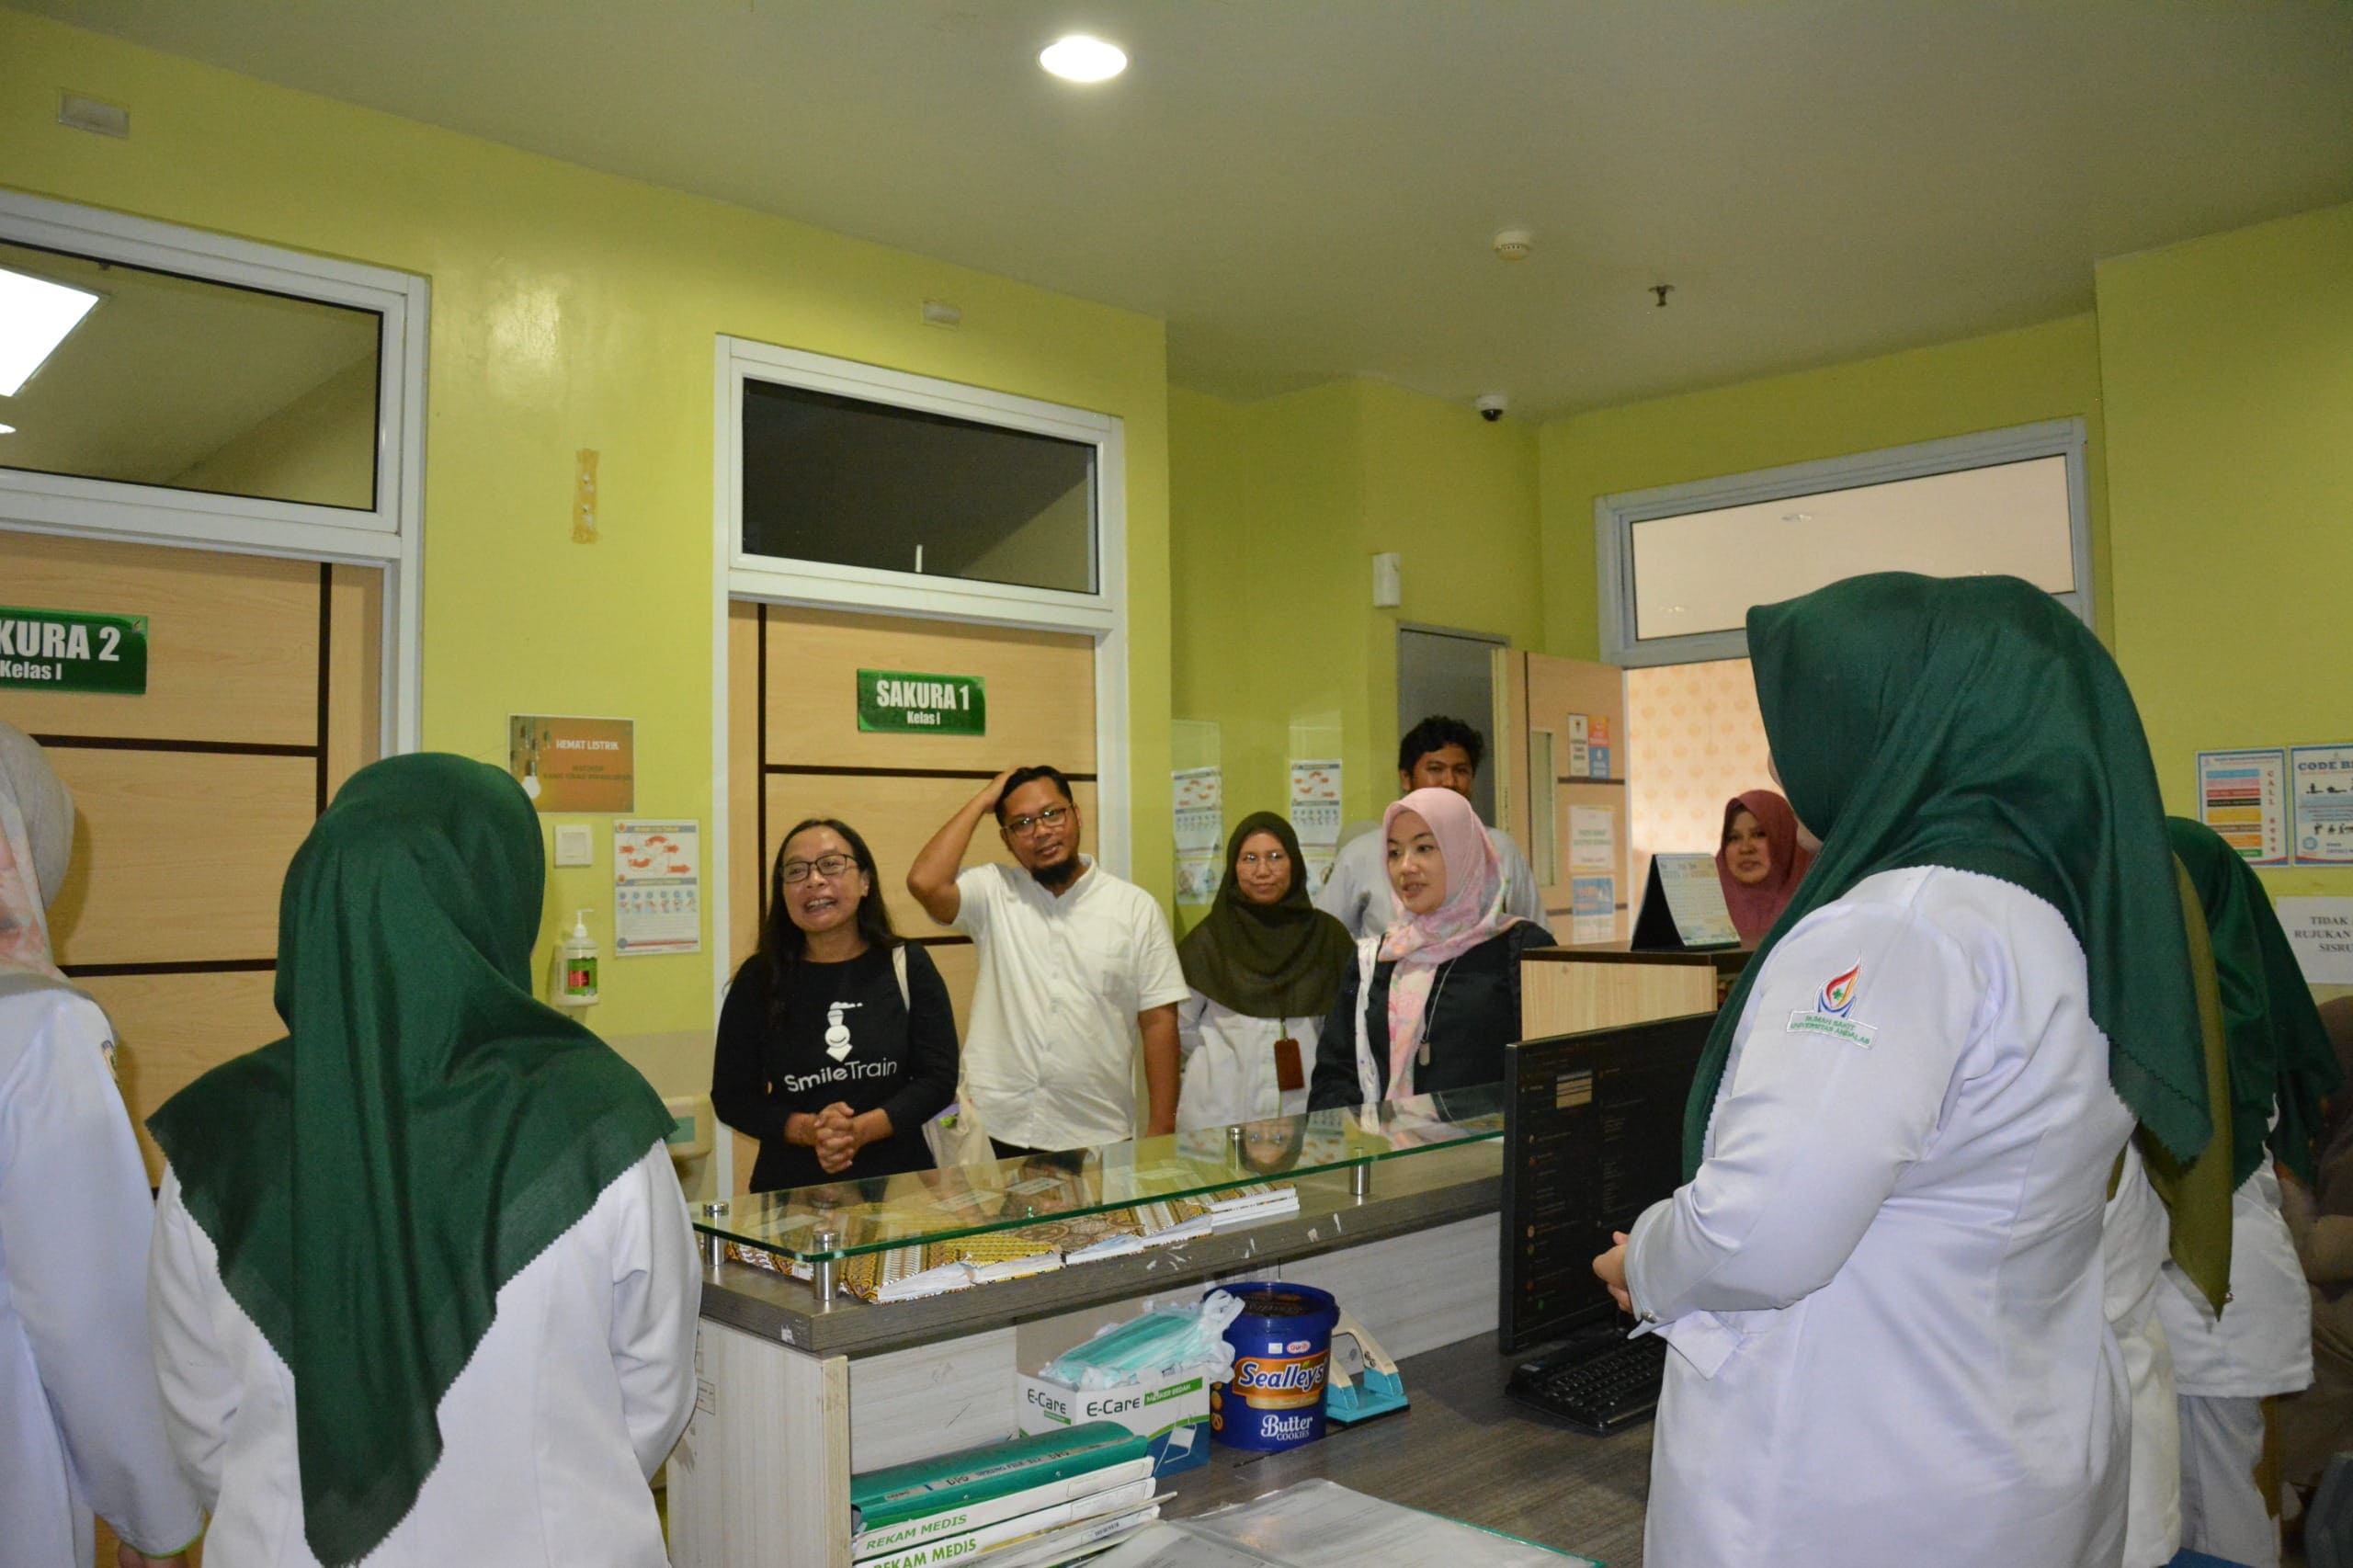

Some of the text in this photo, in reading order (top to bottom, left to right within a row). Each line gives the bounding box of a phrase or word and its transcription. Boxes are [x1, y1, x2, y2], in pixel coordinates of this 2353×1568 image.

[98, 626, 121, 662] 2
[0, 659, 51, 680] Kelas
[876, 679, 970, 710] SAKURA 1
[907, 710, 935, 724] Kelas
[587, 741, 619, 750] LISTRIK
[2298, 760, 2353, 770] CODE B
[2309, 915, 2347, 925] TIDAK
[2294, 929, 2350, 938] RUJUKAN
[784, 1057, 897, 1092] SmileTrain
[1240, 1360, 1324, 1392] Sealleys
[1028, 1388, 1066, 1415] E-Care
[1086, 1397, 1141, 1417] E-Care
[1260, 1414, 1313, 1437] Butter
[1277, 1430, 1310, 1441] COOKIES
[866, 1514, 968, 1551] REKAM MEDIS
[932, 1538, 977, 1562] MEDIS
